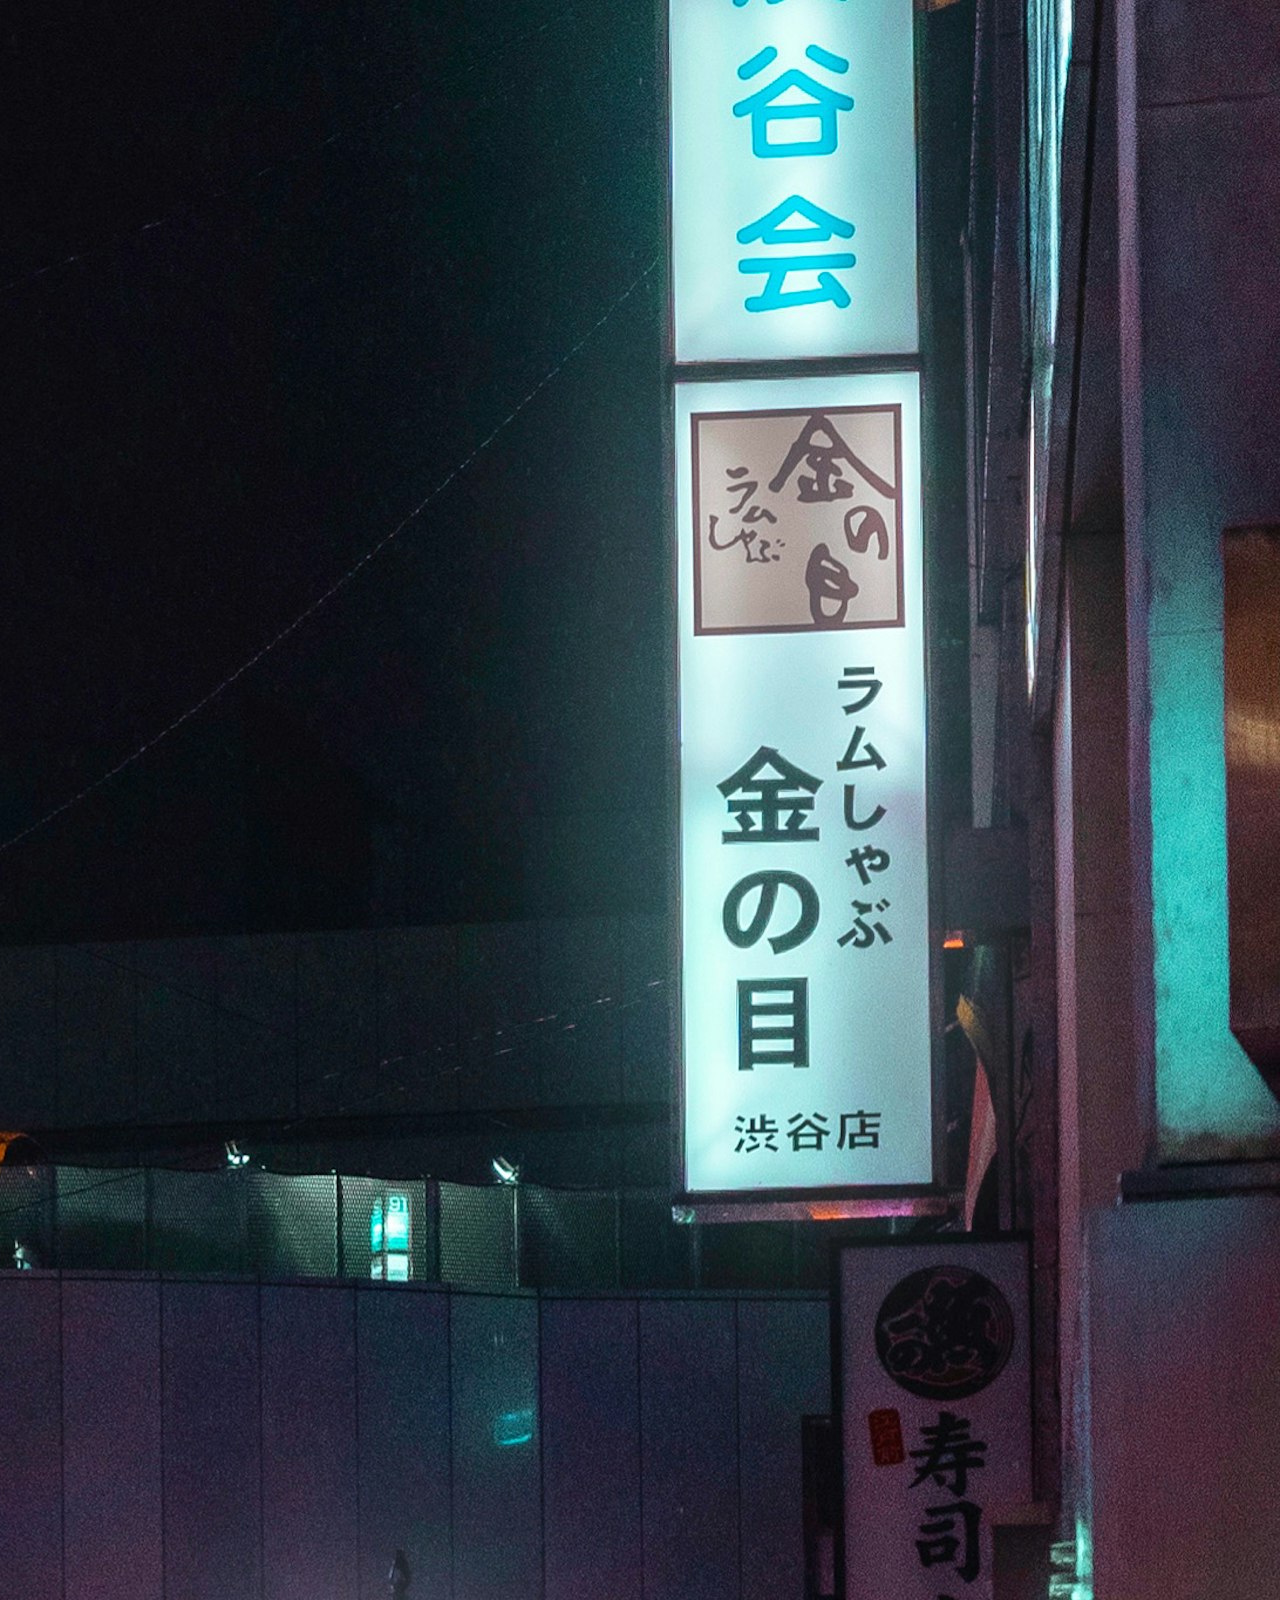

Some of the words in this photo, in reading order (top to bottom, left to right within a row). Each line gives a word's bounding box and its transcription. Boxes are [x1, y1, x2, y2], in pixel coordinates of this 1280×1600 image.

[716, 745, 824, 1072] 金の目
[836, 667, 894, 950] ラムしゃぶ
[734, 1110, 883, 1153] 渋谷店
[907, 1410, 988, 1586] 寿司
